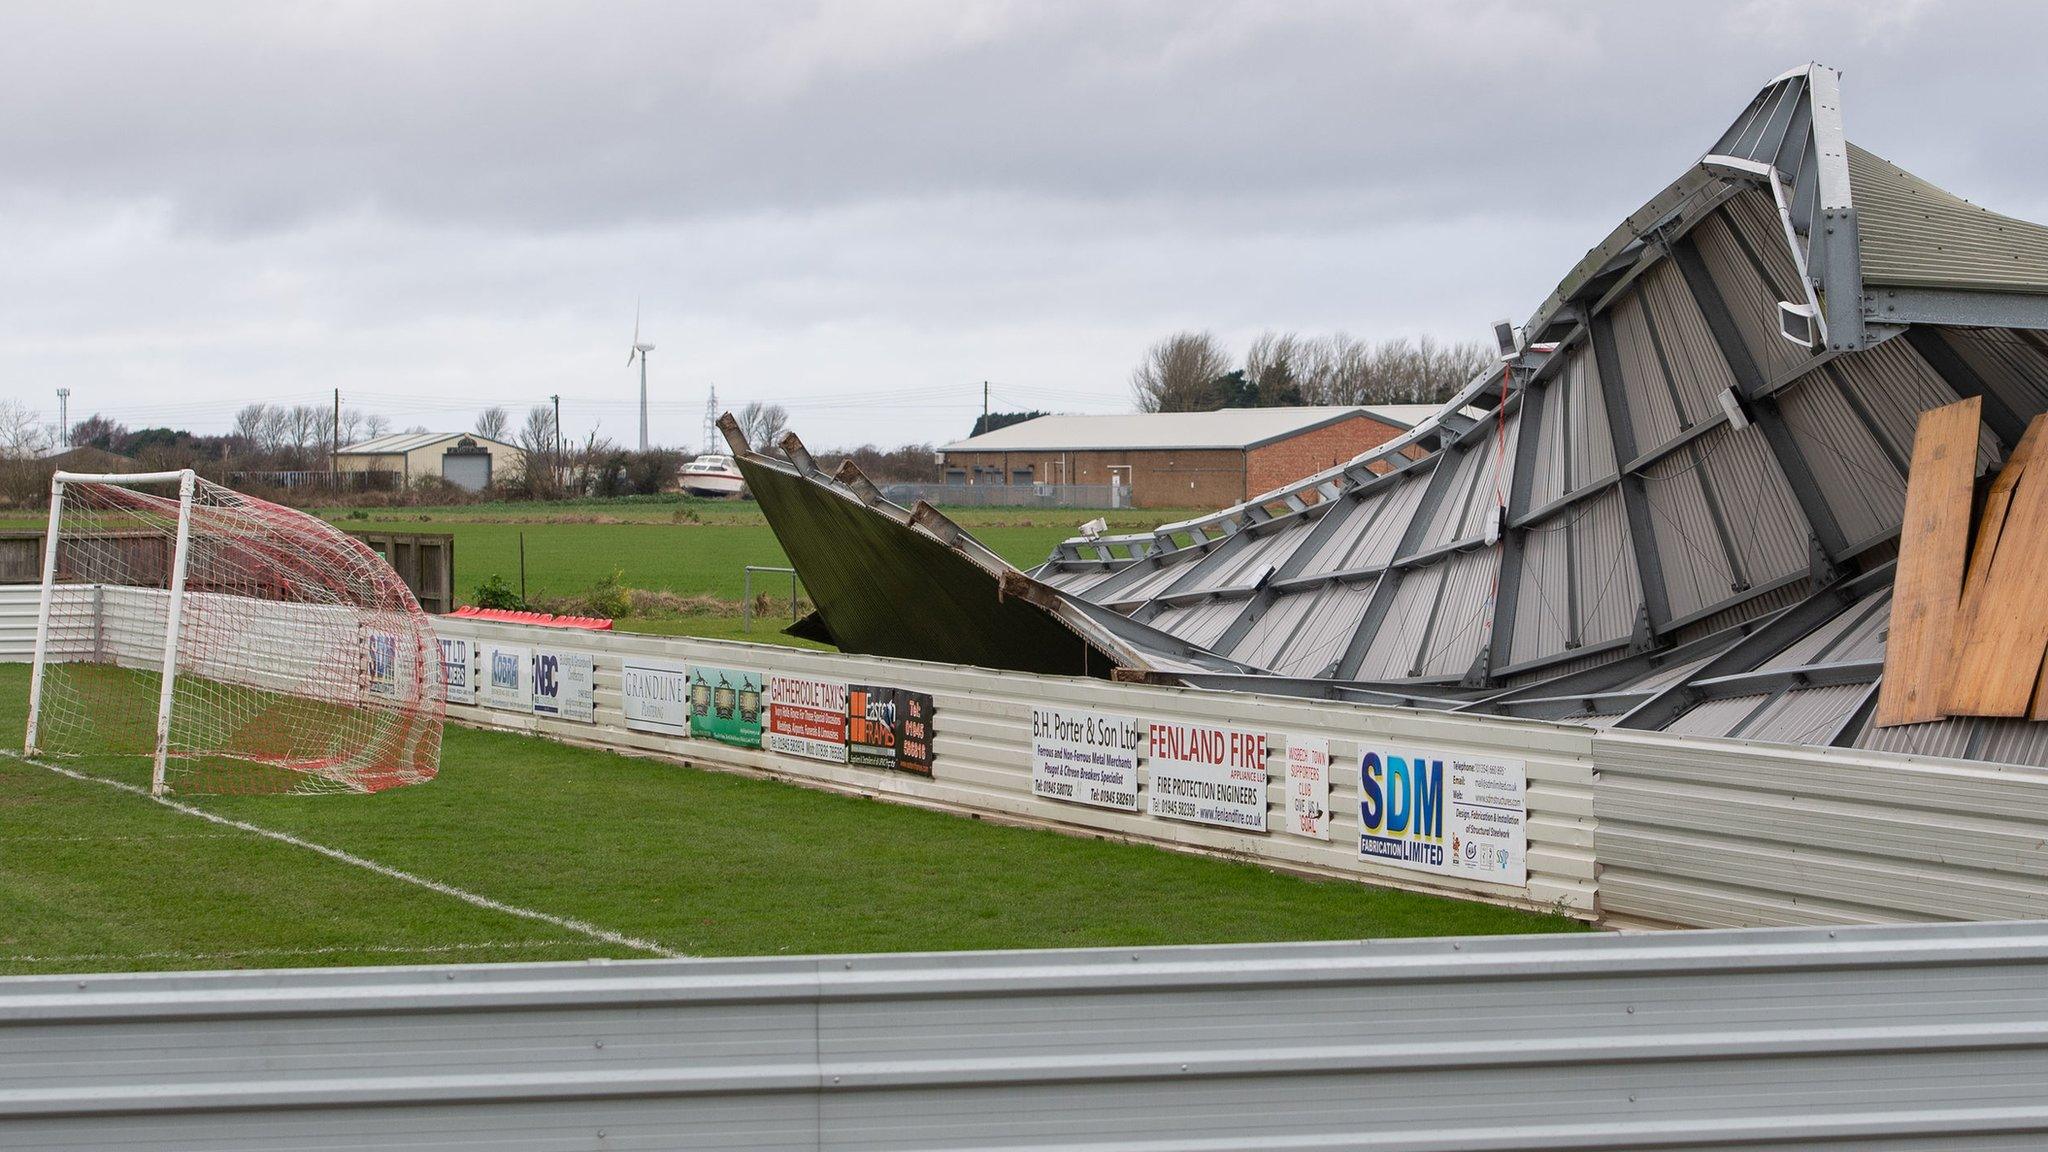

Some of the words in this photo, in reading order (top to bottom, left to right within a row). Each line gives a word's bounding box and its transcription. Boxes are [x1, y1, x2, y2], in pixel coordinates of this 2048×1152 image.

[535, 655, 558, 697] NBC
[625, 672, 682, 703] GRANDLINE
[771, 677, 820, 707] GATHERCOLE
[820, 683, 845, 711] TAXI'S
[865, 693, 896, 722] Easten
[1033, 711, 1052, 739] B.H.
[1054, 713, 1084, 743] Porter
[1086, 717, 1095, 745] &
[1098, 718, 1117, 748] Son
[1120, 721, 1136, 750] Ltd
[1037, 744, 1054, 758] Ferrous
[1054, 747, 1063, 759] and
[1063, 748, 1091, 763] Non-Ferrous
[1092, 752, 1106, 766] Metal
[1106, 754, 1132, 769] Merchants
[1149, 724, 1225, 765] FENLAND
[1230, 732, 1266, 770] FIRE
[1035, 779, 1043, 792] Tel:
[1043, 781, 1056, 794] 01945
[1059, 764, 1064, 776] &
[1080, 768, 1100, 782] Breakers
[1100, 770, 1124, 786] Specialist
[1230, 770, 1256, 782] APPLIANCE
[1091, 788, 1099, 801] Tel:
[1100, 789, 1115, 804] 01945
[1157, 776, 1171, 794] FIRE
[1172, 778, 1216, 801] PROTECTION
[1217, 783, 1257, 806] ENGINEERS
[1298, 783, 1312, 797] CLUB
[1361, 752, 1444, 840] SDM
[1161, 799, 1177, 815] 01945
[1199, 806, 1262, 827] www.fenlandfire.co.uk
[1456, 808, 1470, 820] Design,
[1471, 810, 1493, 821] Fabrication
[1497, 814, 1520, 825] Installation
[1465, 824, 1471, 833] of
[1471, 825, 1490, 836] Structural
[1490, 827, 1510, 838] Steelwork
[1361, 838, 1402, 857] FABRICATION
[1402, 840, 1444, 866] LIMITED
